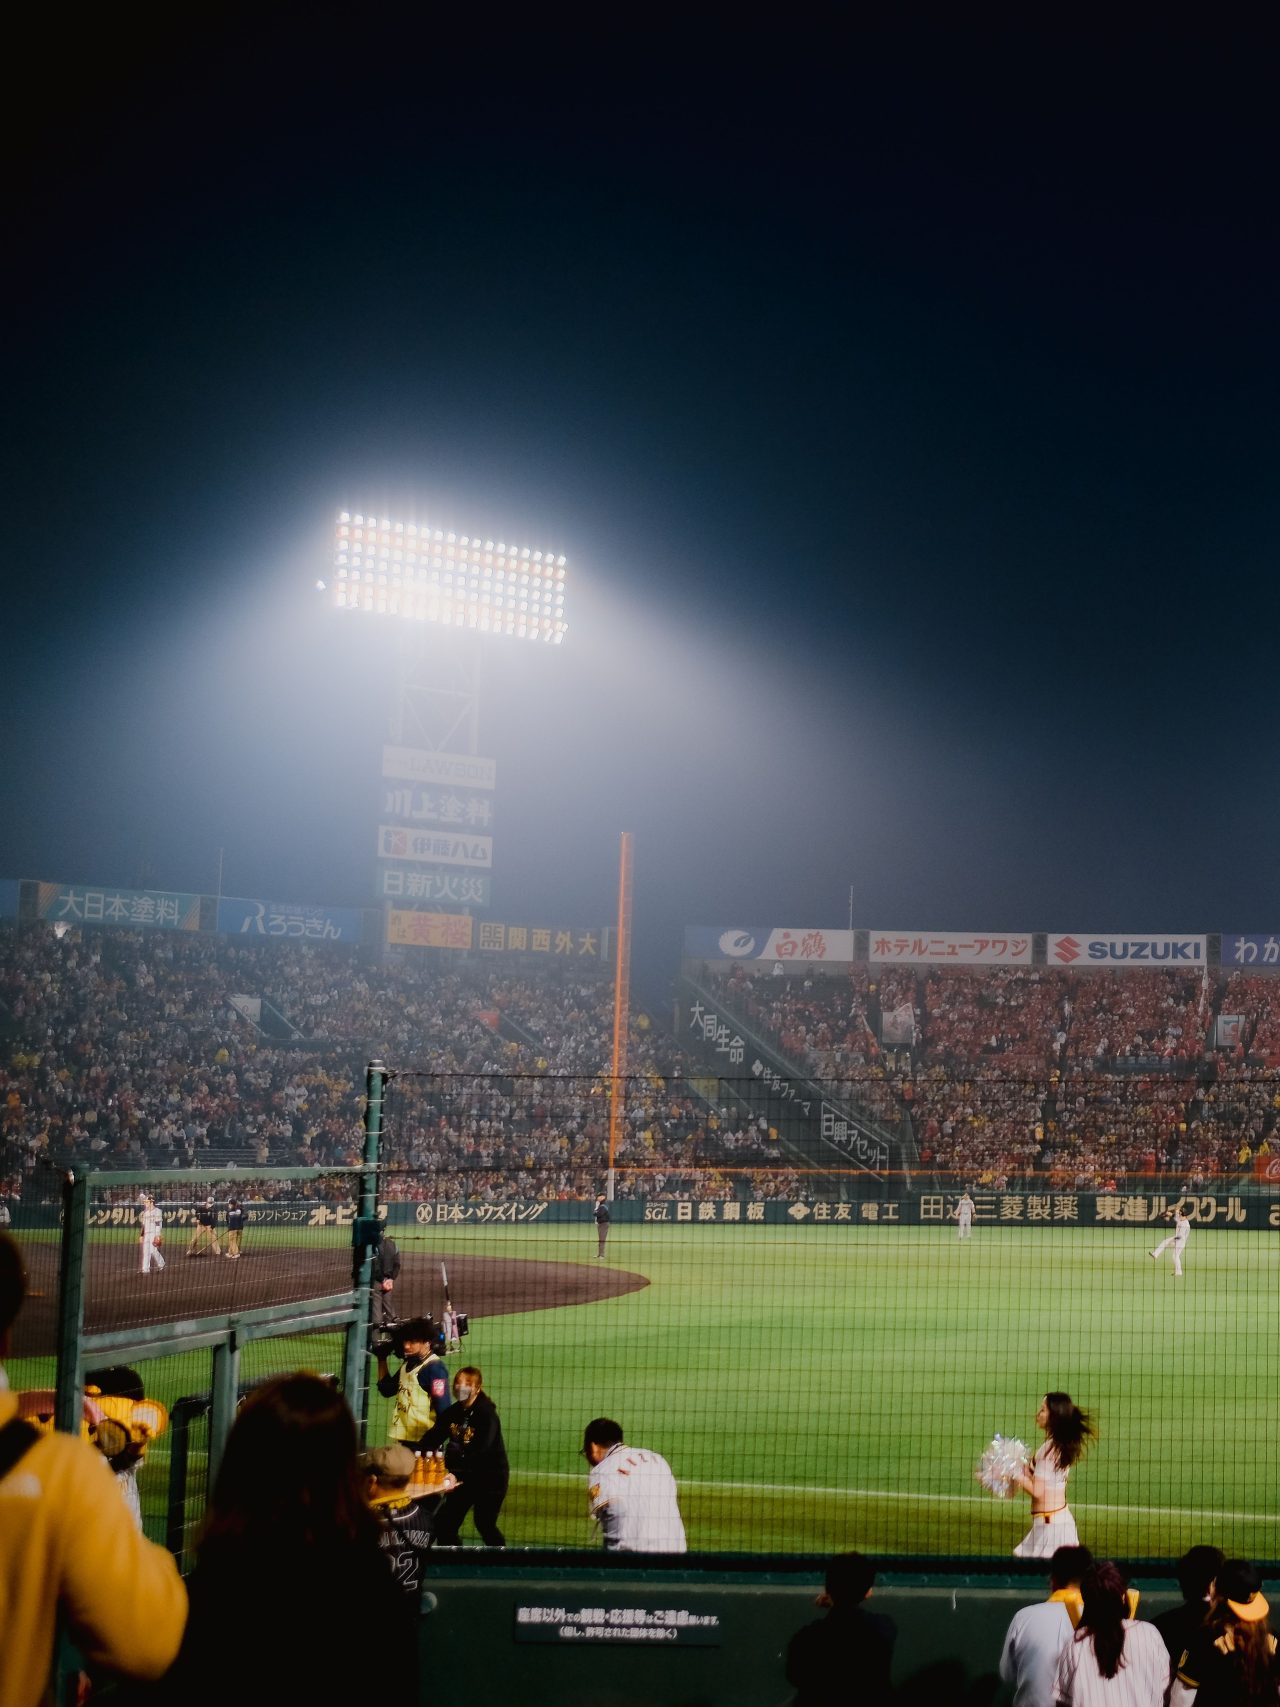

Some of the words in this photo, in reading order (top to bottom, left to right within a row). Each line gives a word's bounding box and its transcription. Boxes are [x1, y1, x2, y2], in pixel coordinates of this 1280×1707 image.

[384, 788, 492, 827] 川上塗料
[412, 837, 488, 860] 伊藤ハム
[383, 870, 483, 903] 日新火災
[58, 890, 181, 926] 大日本塗料
[268, 914, 343, 940] ろうきん
[408, 913, 469, 946] 黄桜
[507, 926, 597, 955] 関西外大
[774, 936, 827, 959] 白鶴
[873, 938, 1029, 957] ホテルニューアワジ
[1088, 941, 1201, 960] SUZUKI
[690, 1000, 745, 1065] 大同生命
[763, 1066, 812, 1117] 住友ファーマ
[823, 1113, 888, 1172] 日興アセット
[308, 1202, 388, 1225] オービ
[436, 1202, 549, 1223] 日本ハウズイング
[677, 1201, 766, 1221] 日鉄鋼板
[813, 1202, 901, 1220] 住友電工
